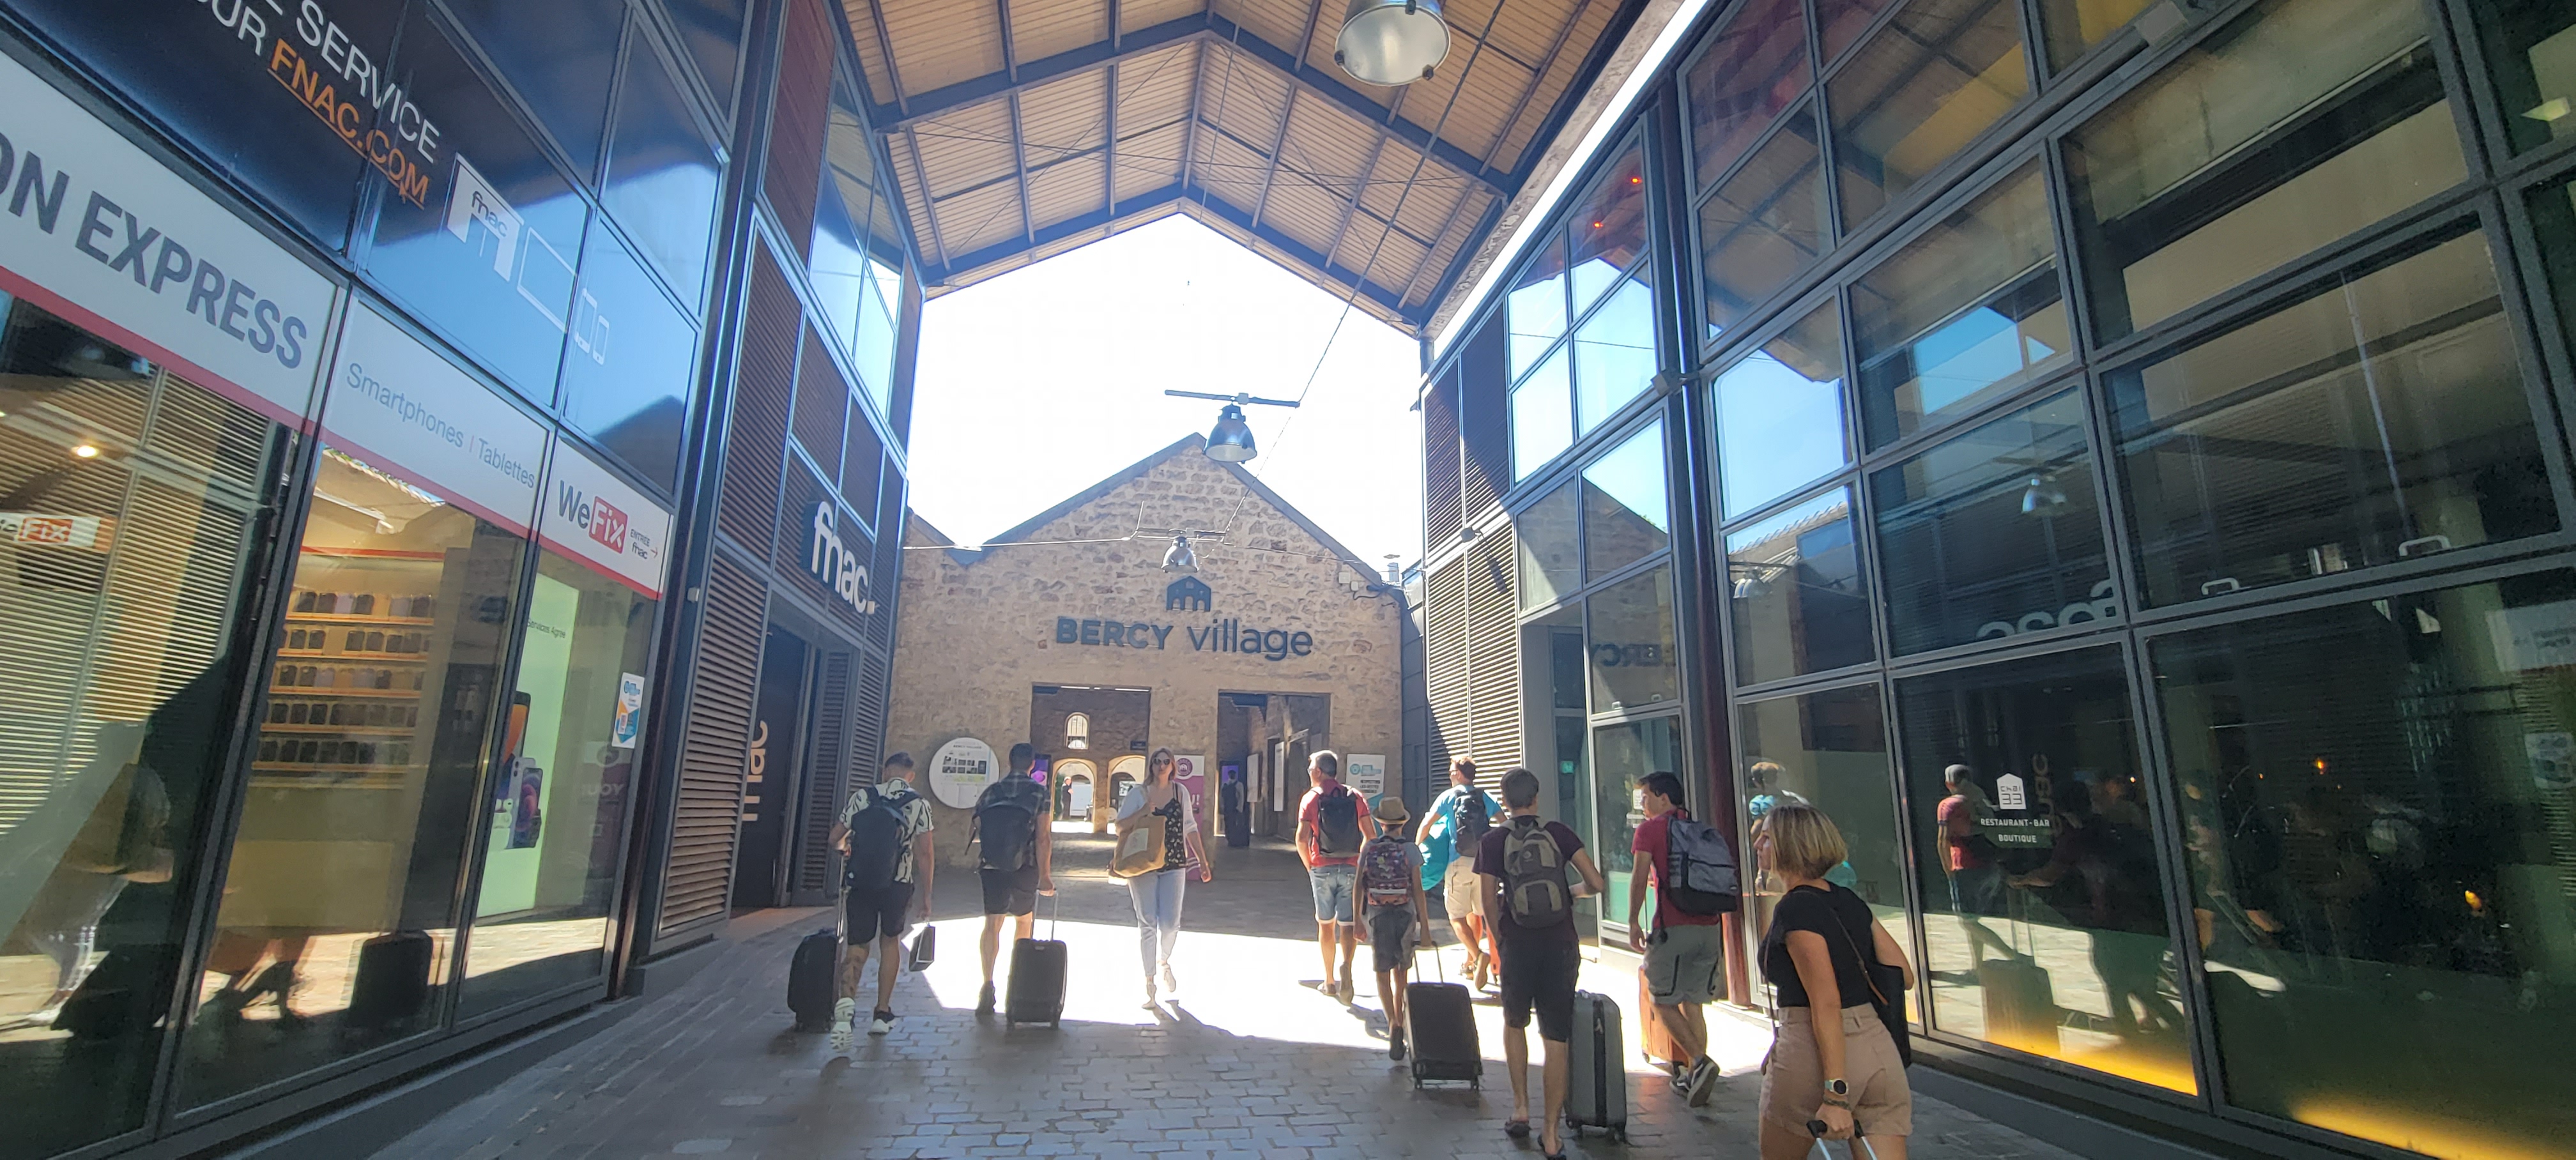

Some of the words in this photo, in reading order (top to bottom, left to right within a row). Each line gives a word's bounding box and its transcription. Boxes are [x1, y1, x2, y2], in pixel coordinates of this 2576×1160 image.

[197, 0, 266, 56] UR
[271, 38, 429, 204] FNAC.COM
[296, 0, 440, 164] SERVICE
[471, 190, 508, 238] fnac
[75, 190, 307, 369] EXPRESS
[347, 362, 464, 448] Smartphones
[479, 438, 535, 489] Tablettes
[558, 480, 625, 549] WeFix
[632, 541, 648, 560] fnac
[811, 501, 868, 613] fnac
[1056, 616, 1174, 650] BERCY
[1186, 618, 1314, 662] village
[2001, 793, 2023, 805] 33
[1998, 834, 2037, 843] BOUTIQUE
